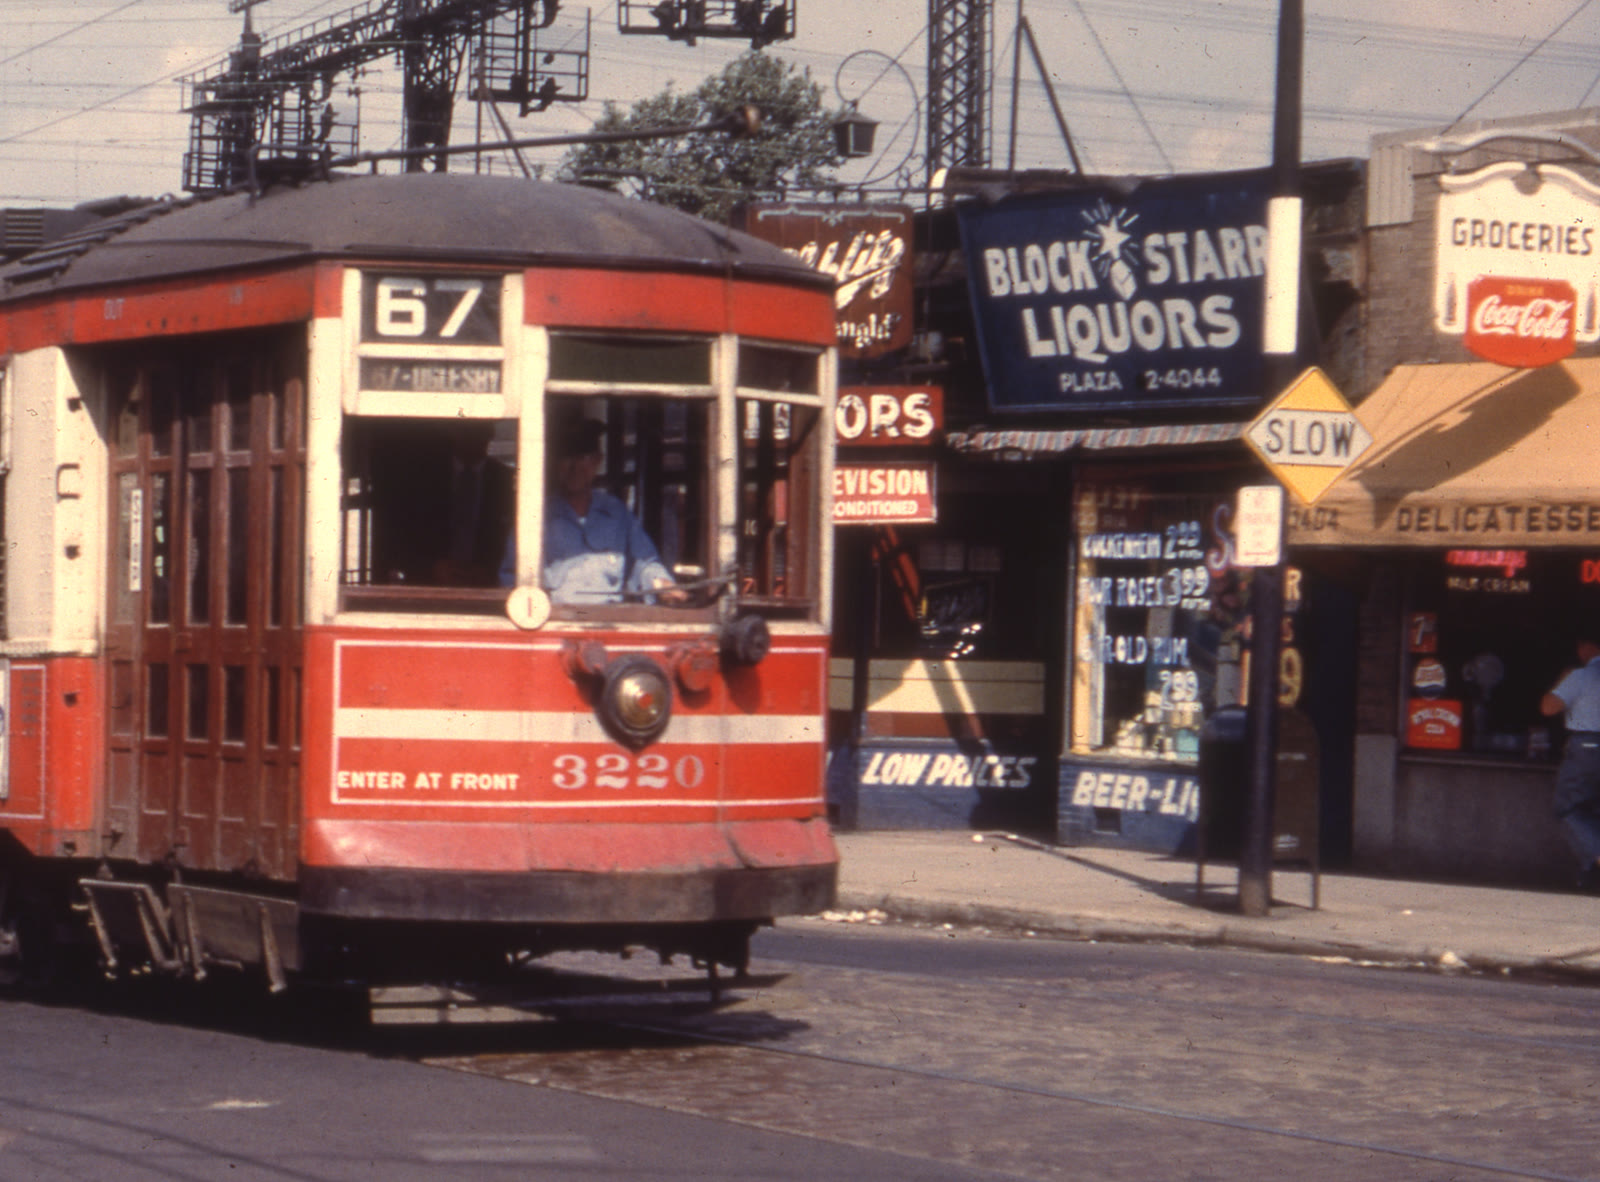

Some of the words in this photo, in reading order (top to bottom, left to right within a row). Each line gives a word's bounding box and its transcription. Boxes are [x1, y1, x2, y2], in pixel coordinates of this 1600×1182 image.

[1452, 217, 1594, 256] GROCERIES
[984, 240, 1098, 297] BLOCK
[1144, 225, 1268, 285] STARR
[376, 276, 485, 338] 67
[1023, 294, 1241, 363] LIQUORS
[1060, 371, 1123, 392] PLAZA
[1265, 417, 1356, 456] SLOW
[833, 469, 927, 495] EVISION
[831, 500, 918, 517] ONDITIONED
[337, 770, 406, 789] ENTER
[414, 772, 442, 789] AT
[451, 773, 519, 791] FRONT
[552, 754, 704, 790] 3220
[861, 753, 923, 784] LOW
[925, 754, 1037, 788] PRICES
